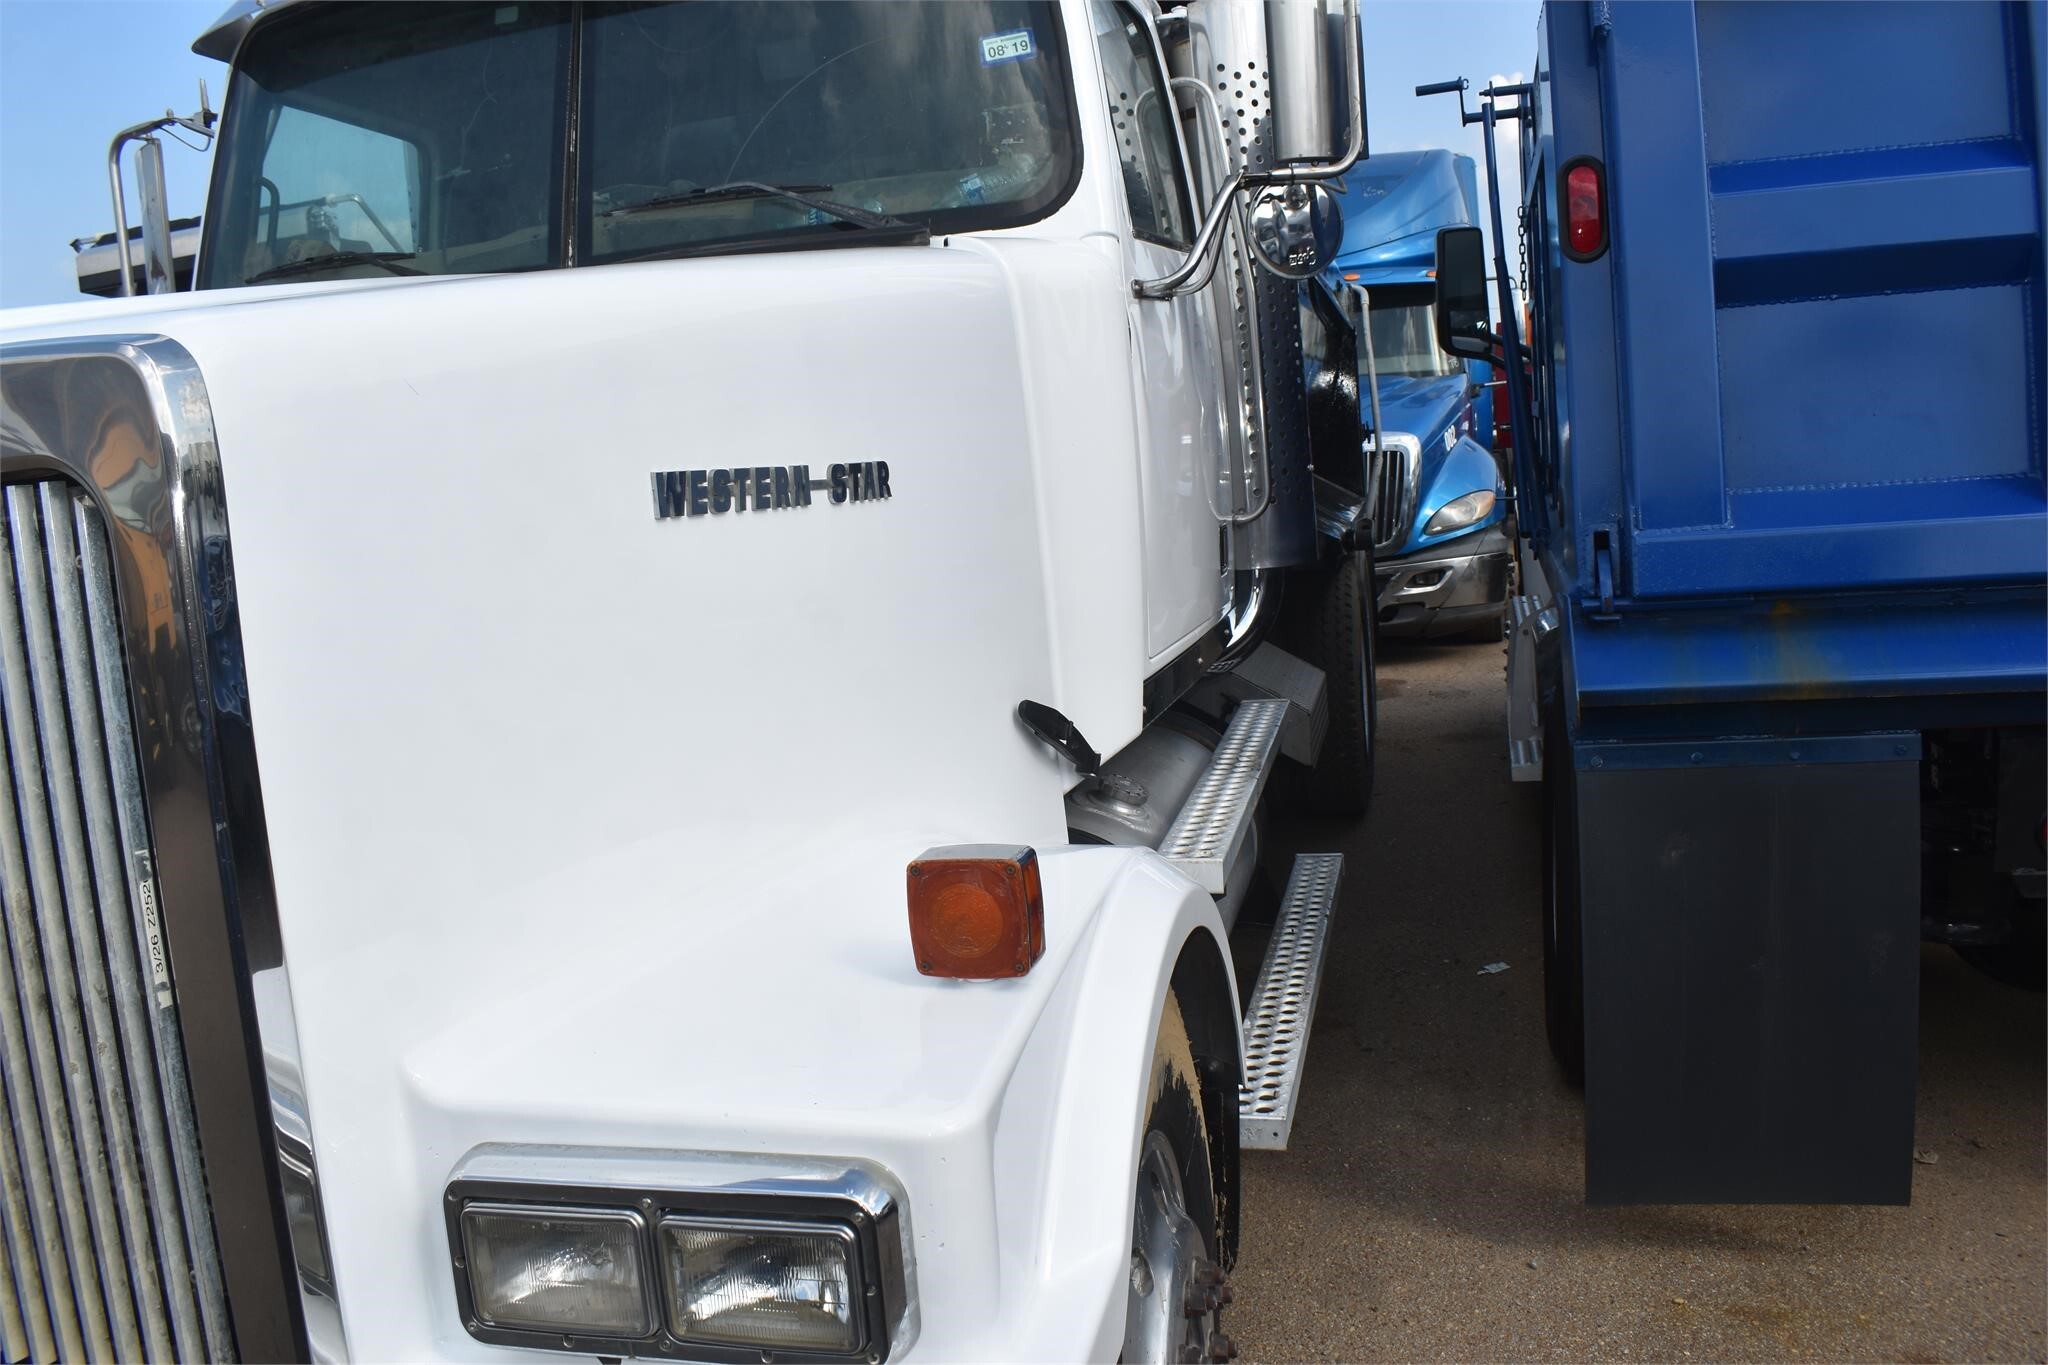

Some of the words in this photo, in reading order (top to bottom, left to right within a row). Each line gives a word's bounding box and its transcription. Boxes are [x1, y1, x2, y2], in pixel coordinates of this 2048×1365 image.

[988, 45, 1005, 58] 08
[1012, 40, 1029, 53] 19
[650, 464, 812, 520] WESTERN
[827, 460, 893, 504] STAR
[142, 879, 156, 927] Z252
[150, 934, 164, 974] 3/26
